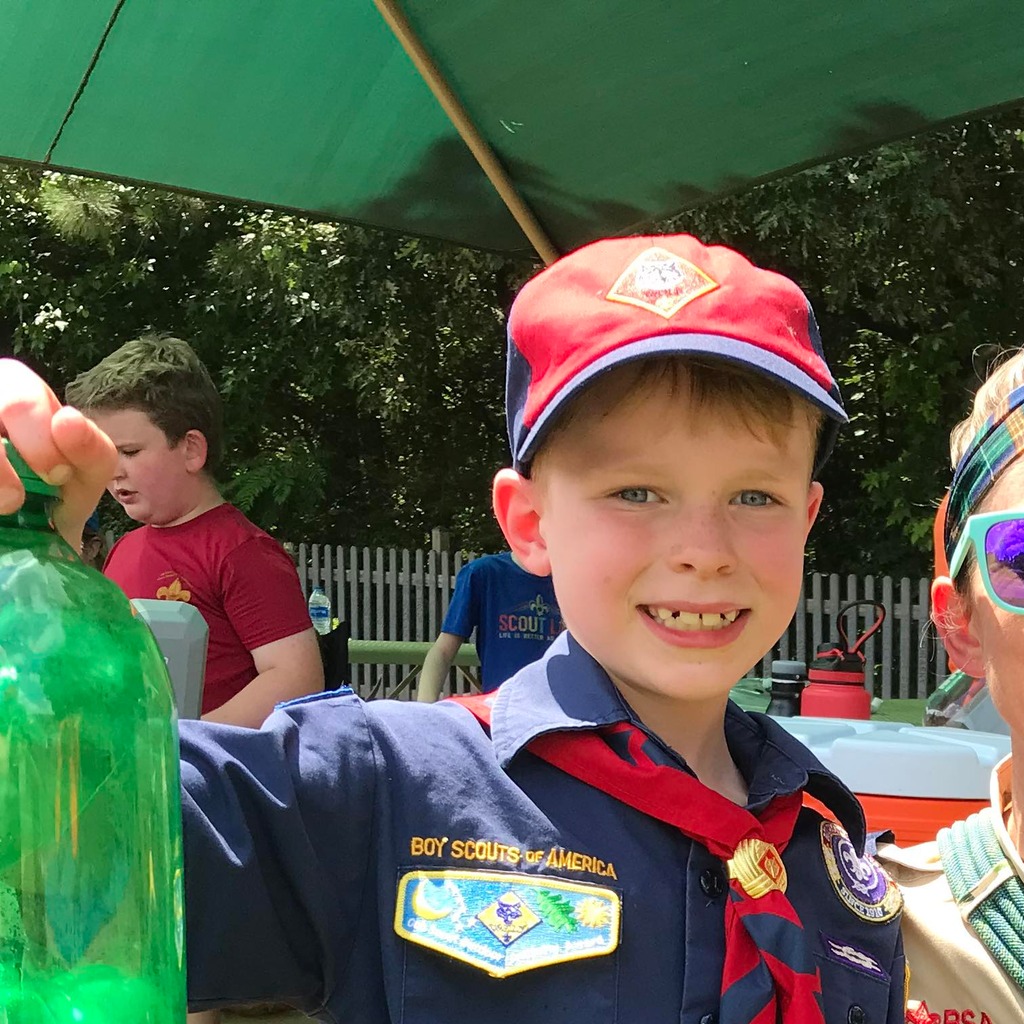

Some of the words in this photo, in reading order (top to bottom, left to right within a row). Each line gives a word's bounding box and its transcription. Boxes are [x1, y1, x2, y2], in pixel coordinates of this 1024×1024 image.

[499, 614, 546, 633] SCOUT
[411, 837, 445, 858] BOY
[451, 839, 520, 864] SCOUTS
[546, 847, 618, 880] AMERICA
